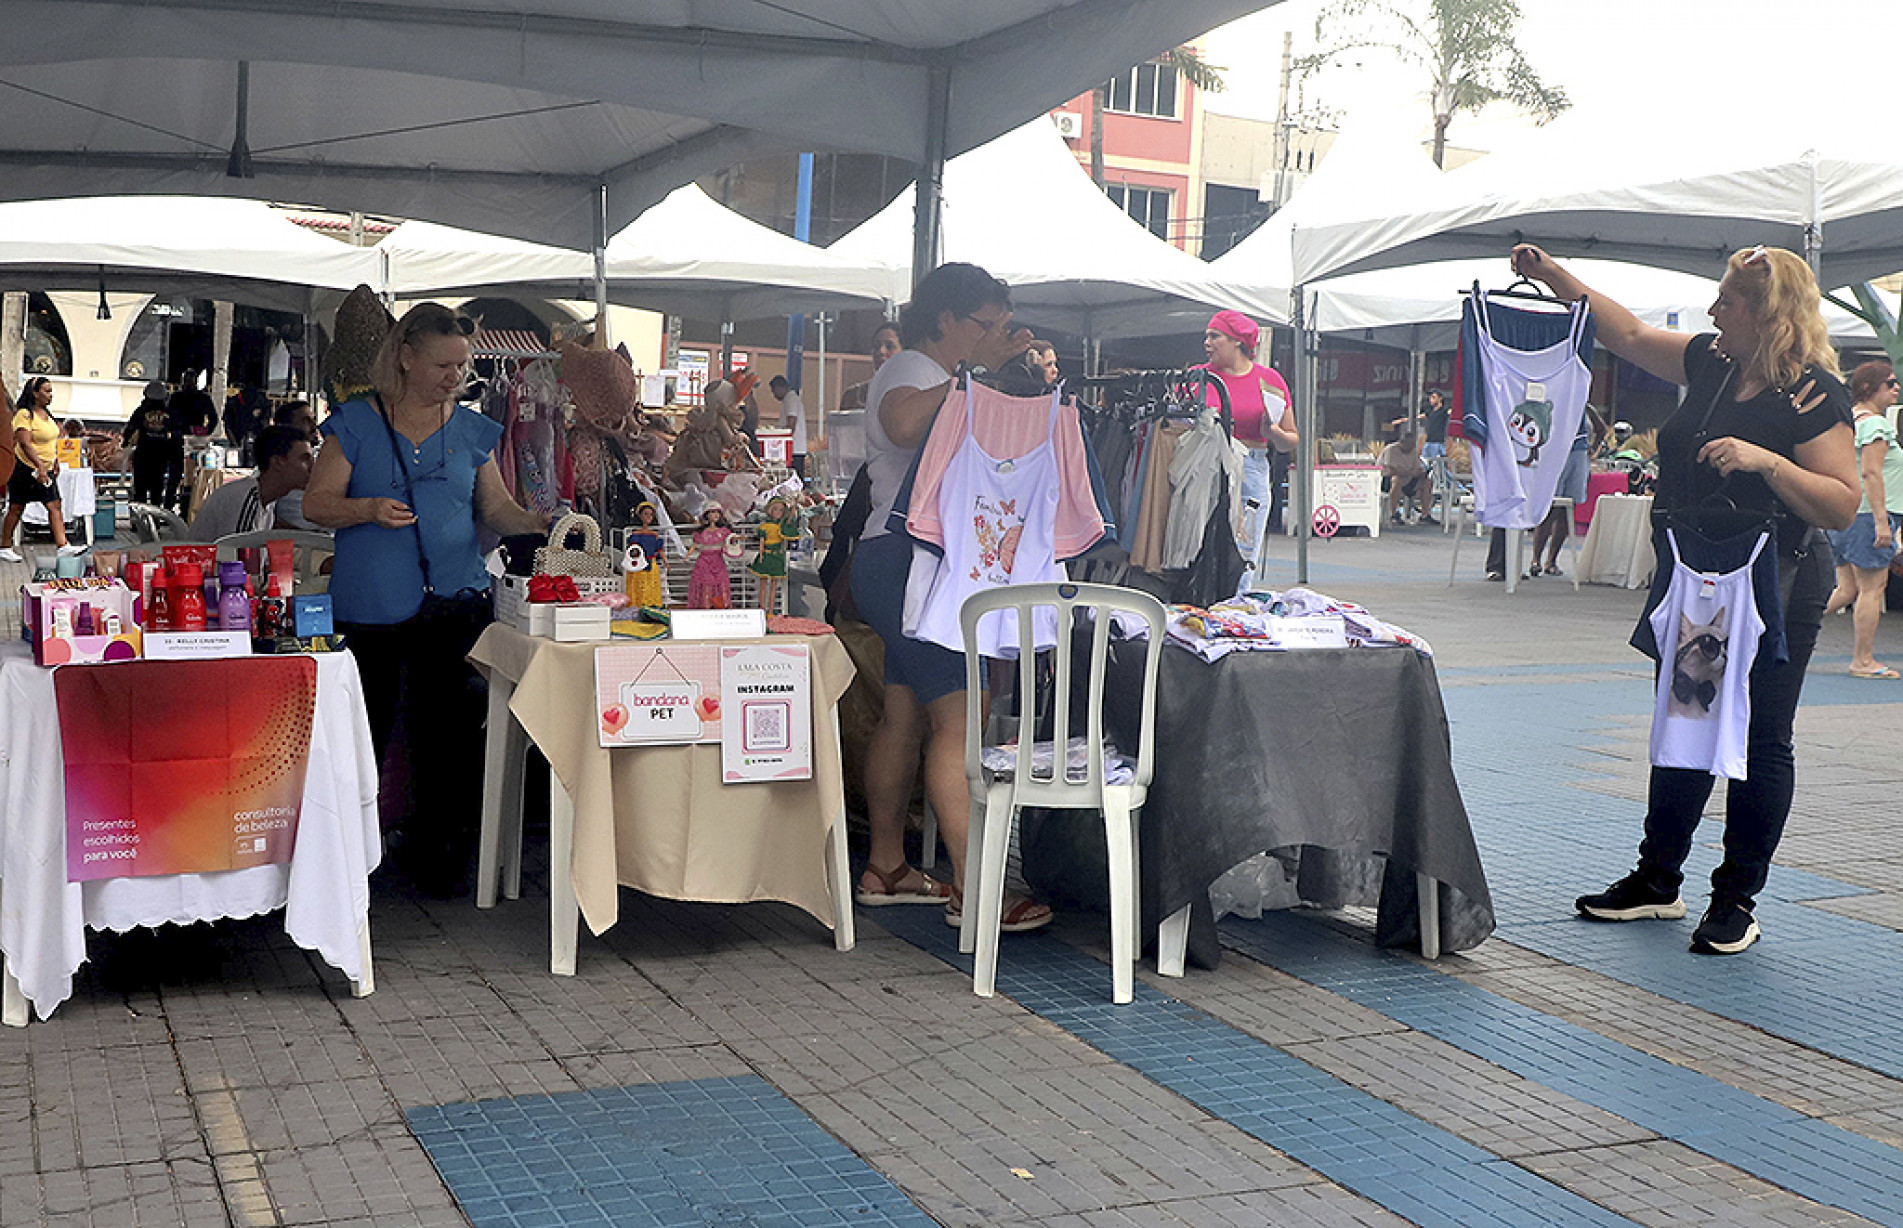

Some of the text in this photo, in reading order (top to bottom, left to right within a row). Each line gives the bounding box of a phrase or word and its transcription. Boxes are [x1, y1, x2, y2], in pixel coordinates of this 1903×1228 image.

[737, 685, 795, 693] INSTAGRAM
[633, 692, 689, 707] bandana
[650, 707, 675, 719] PET
[233, 806, 296, 821] consultoria
[83, 819, 137, 831] Presentes
[233, 819, 288, 834] de beleza
[83, 833, 140, 847] escolhidos
[83, 848, 136, 864] para você
